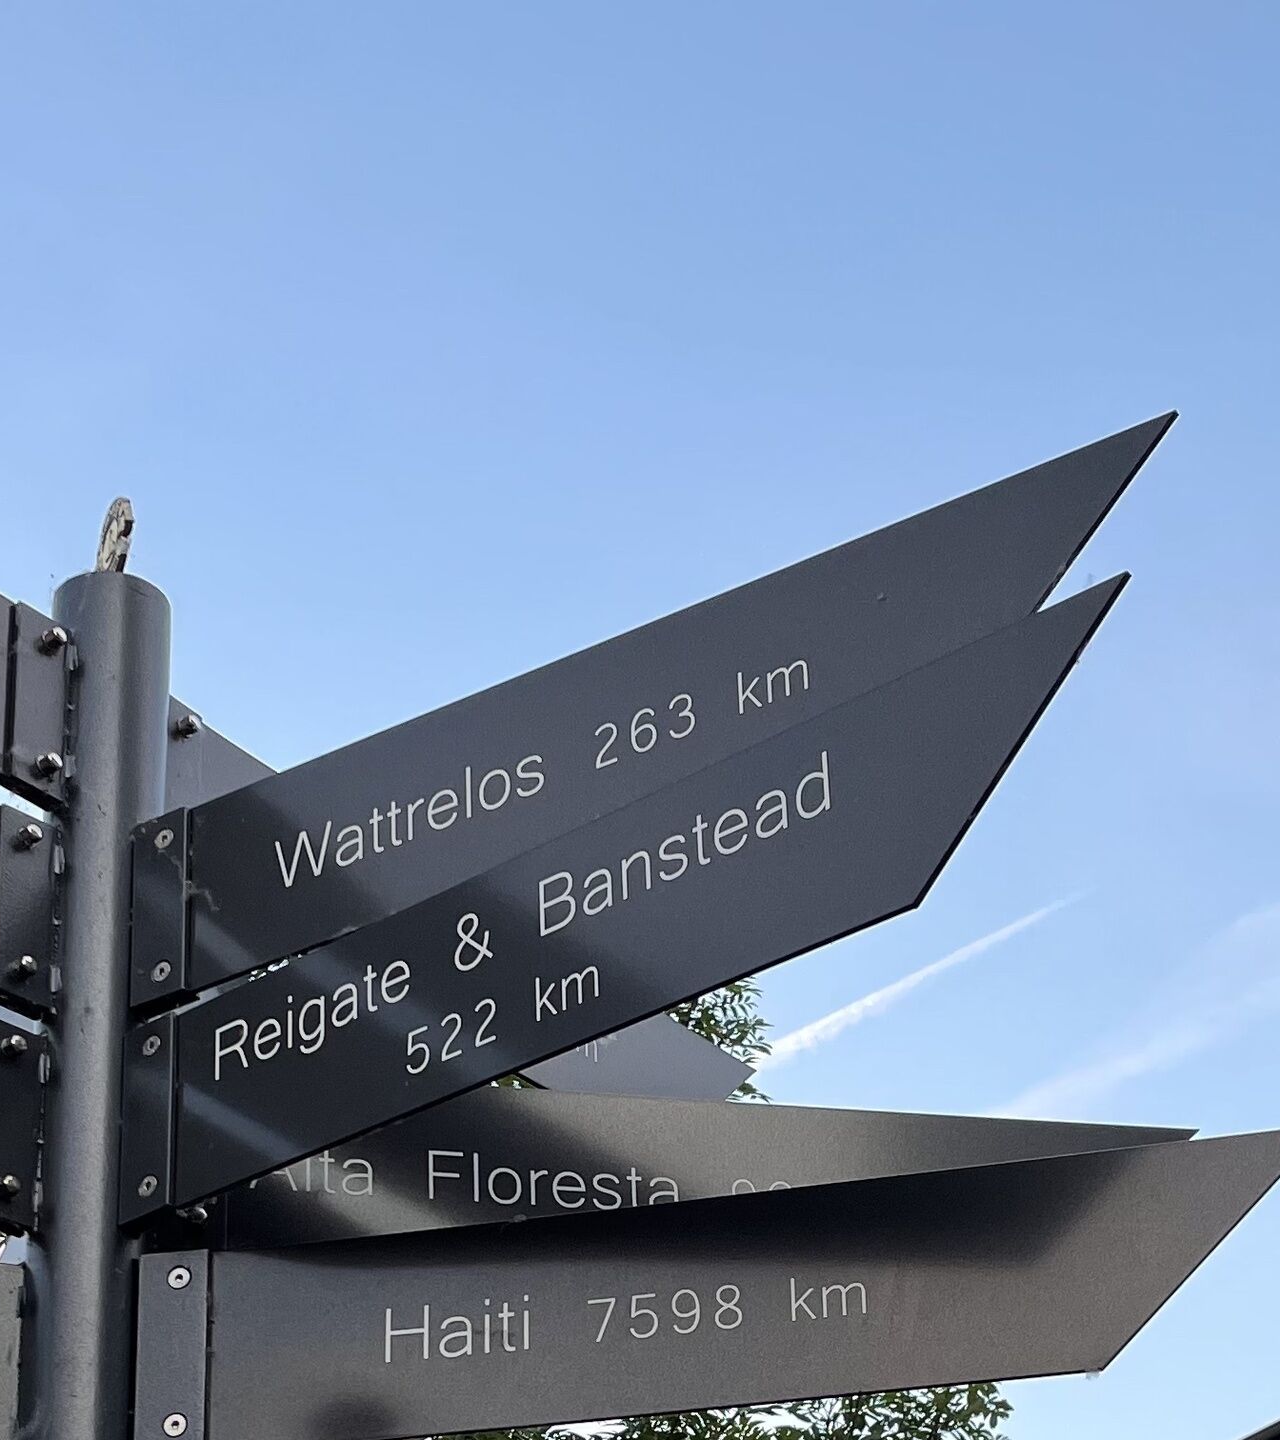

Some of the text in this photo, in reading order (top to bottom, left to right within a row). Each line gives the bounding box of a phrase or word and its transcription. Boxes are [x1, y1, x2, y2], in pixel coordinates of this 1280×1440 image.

[274, 656, 811, 889] Wattrelos 263 km
[212, 750, 835, 1082] Reigate & Banstead
[405, 964, 601, 1076] 522 km
[428, 1150, 680, 1211] Floresta
[383, 1276, 868, 1363] Haiti 7598 km
